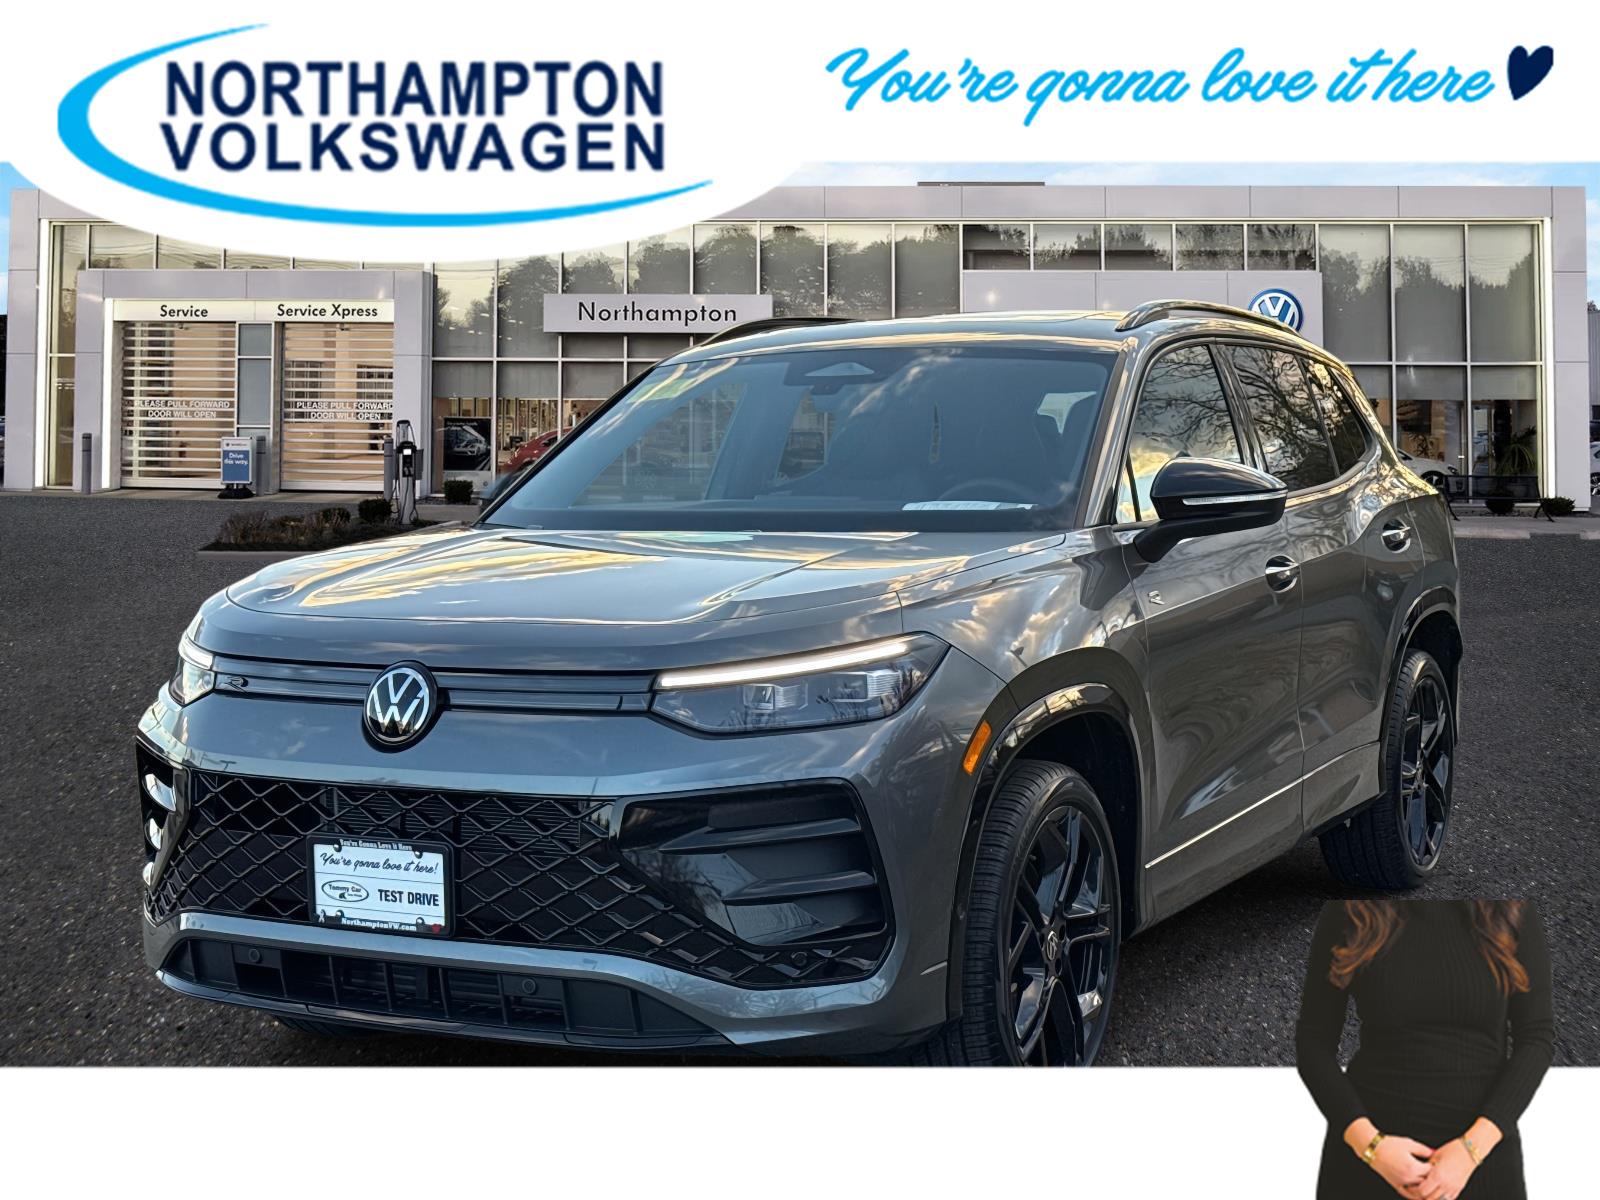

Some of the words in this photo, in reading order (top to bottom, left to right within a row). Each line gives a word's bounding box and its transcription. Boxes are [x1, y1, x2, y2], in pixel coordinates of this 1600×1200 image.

[159, 304, 209, 318] Service
[276, 303, 327, 318] Service
[330, 303, 379, 320] Xpress
[577, 301, 738, 327] Northampton
[134, 399, 166, 409] PLEASE
[167, 400, 188, 409] PULL
[189, 400, 230, 409] FORWARD
[296, 401, 329, 410] PLEASE
[330, 401, 352, 411] PULL
[353, 402, 394, 411] FORWARD
[147, 410, 171, 418] DOOR
[172, 410, 193, 419] WILL
[193, 410, 217, 419] OPEN
[310, 411, 335, 420] DOOR
[336, 411, 356, 420] WILL
[357, 412, 381, 421] OPEN
[320, 852, 352, 867] You're
[353, 859, 381, 872] gonna
[381, 858, 402, 871] love
[401, 860, 415, 872] it
[413, 862, 439, 875] here!
[377, 888, 404, 904] TEST
[407, 891, 440, 907] DRIVE
[341, 917, 417, 932] NorthamptonVW.com
